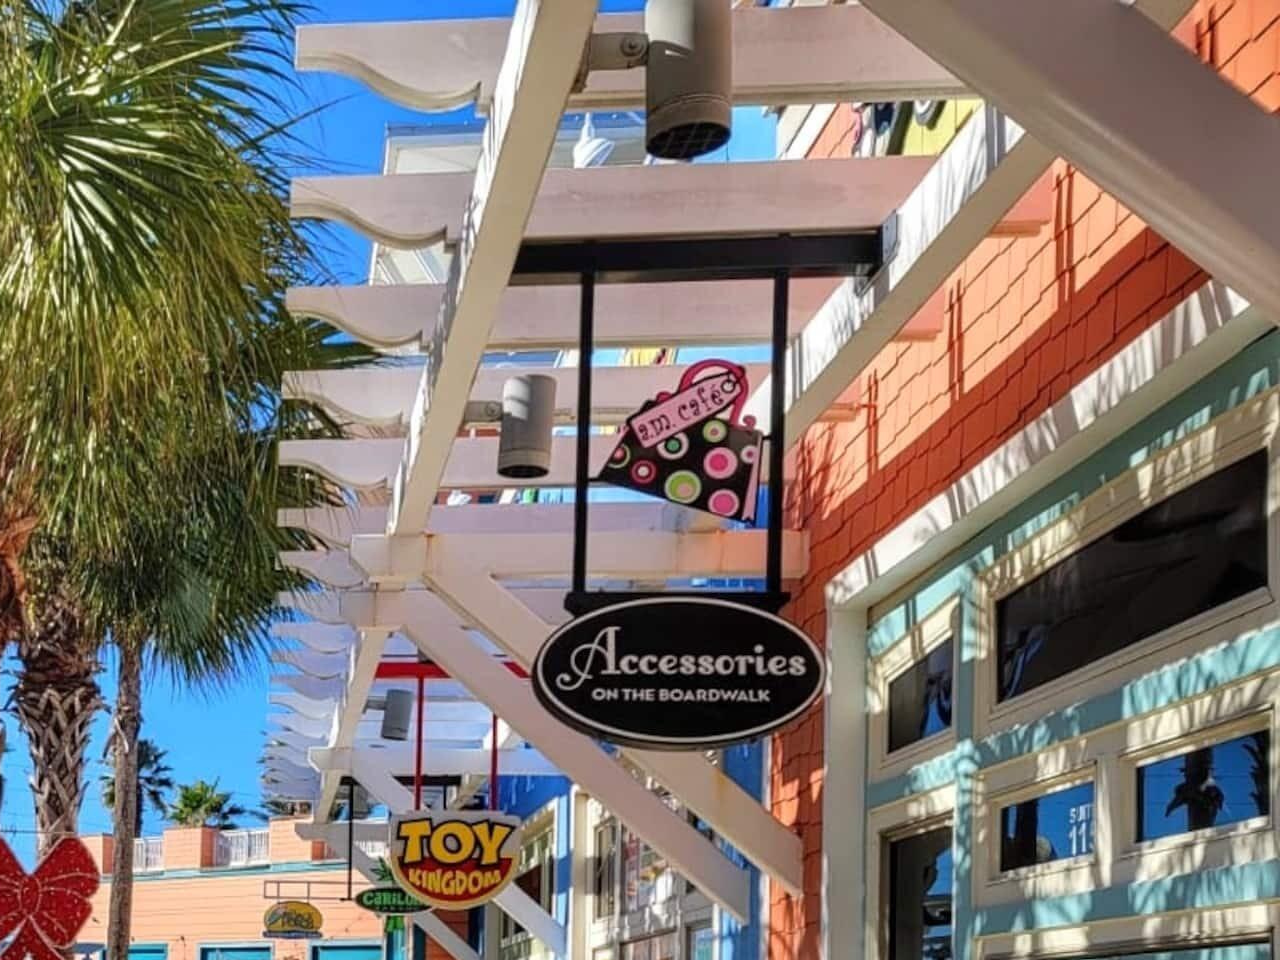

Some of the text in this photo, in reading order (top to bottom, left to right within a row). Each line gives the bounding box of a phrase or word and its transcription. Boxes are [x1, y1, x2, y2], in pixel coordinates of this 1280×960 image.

[678, 384, 725, 421] café
[556, 626, 806, 690] Accessories
[592, 687, 770, 702] ON THE BOARDWALK
[398, 818, 516, 866] TOY
[408, 867, 502, 896] KINGDOM
